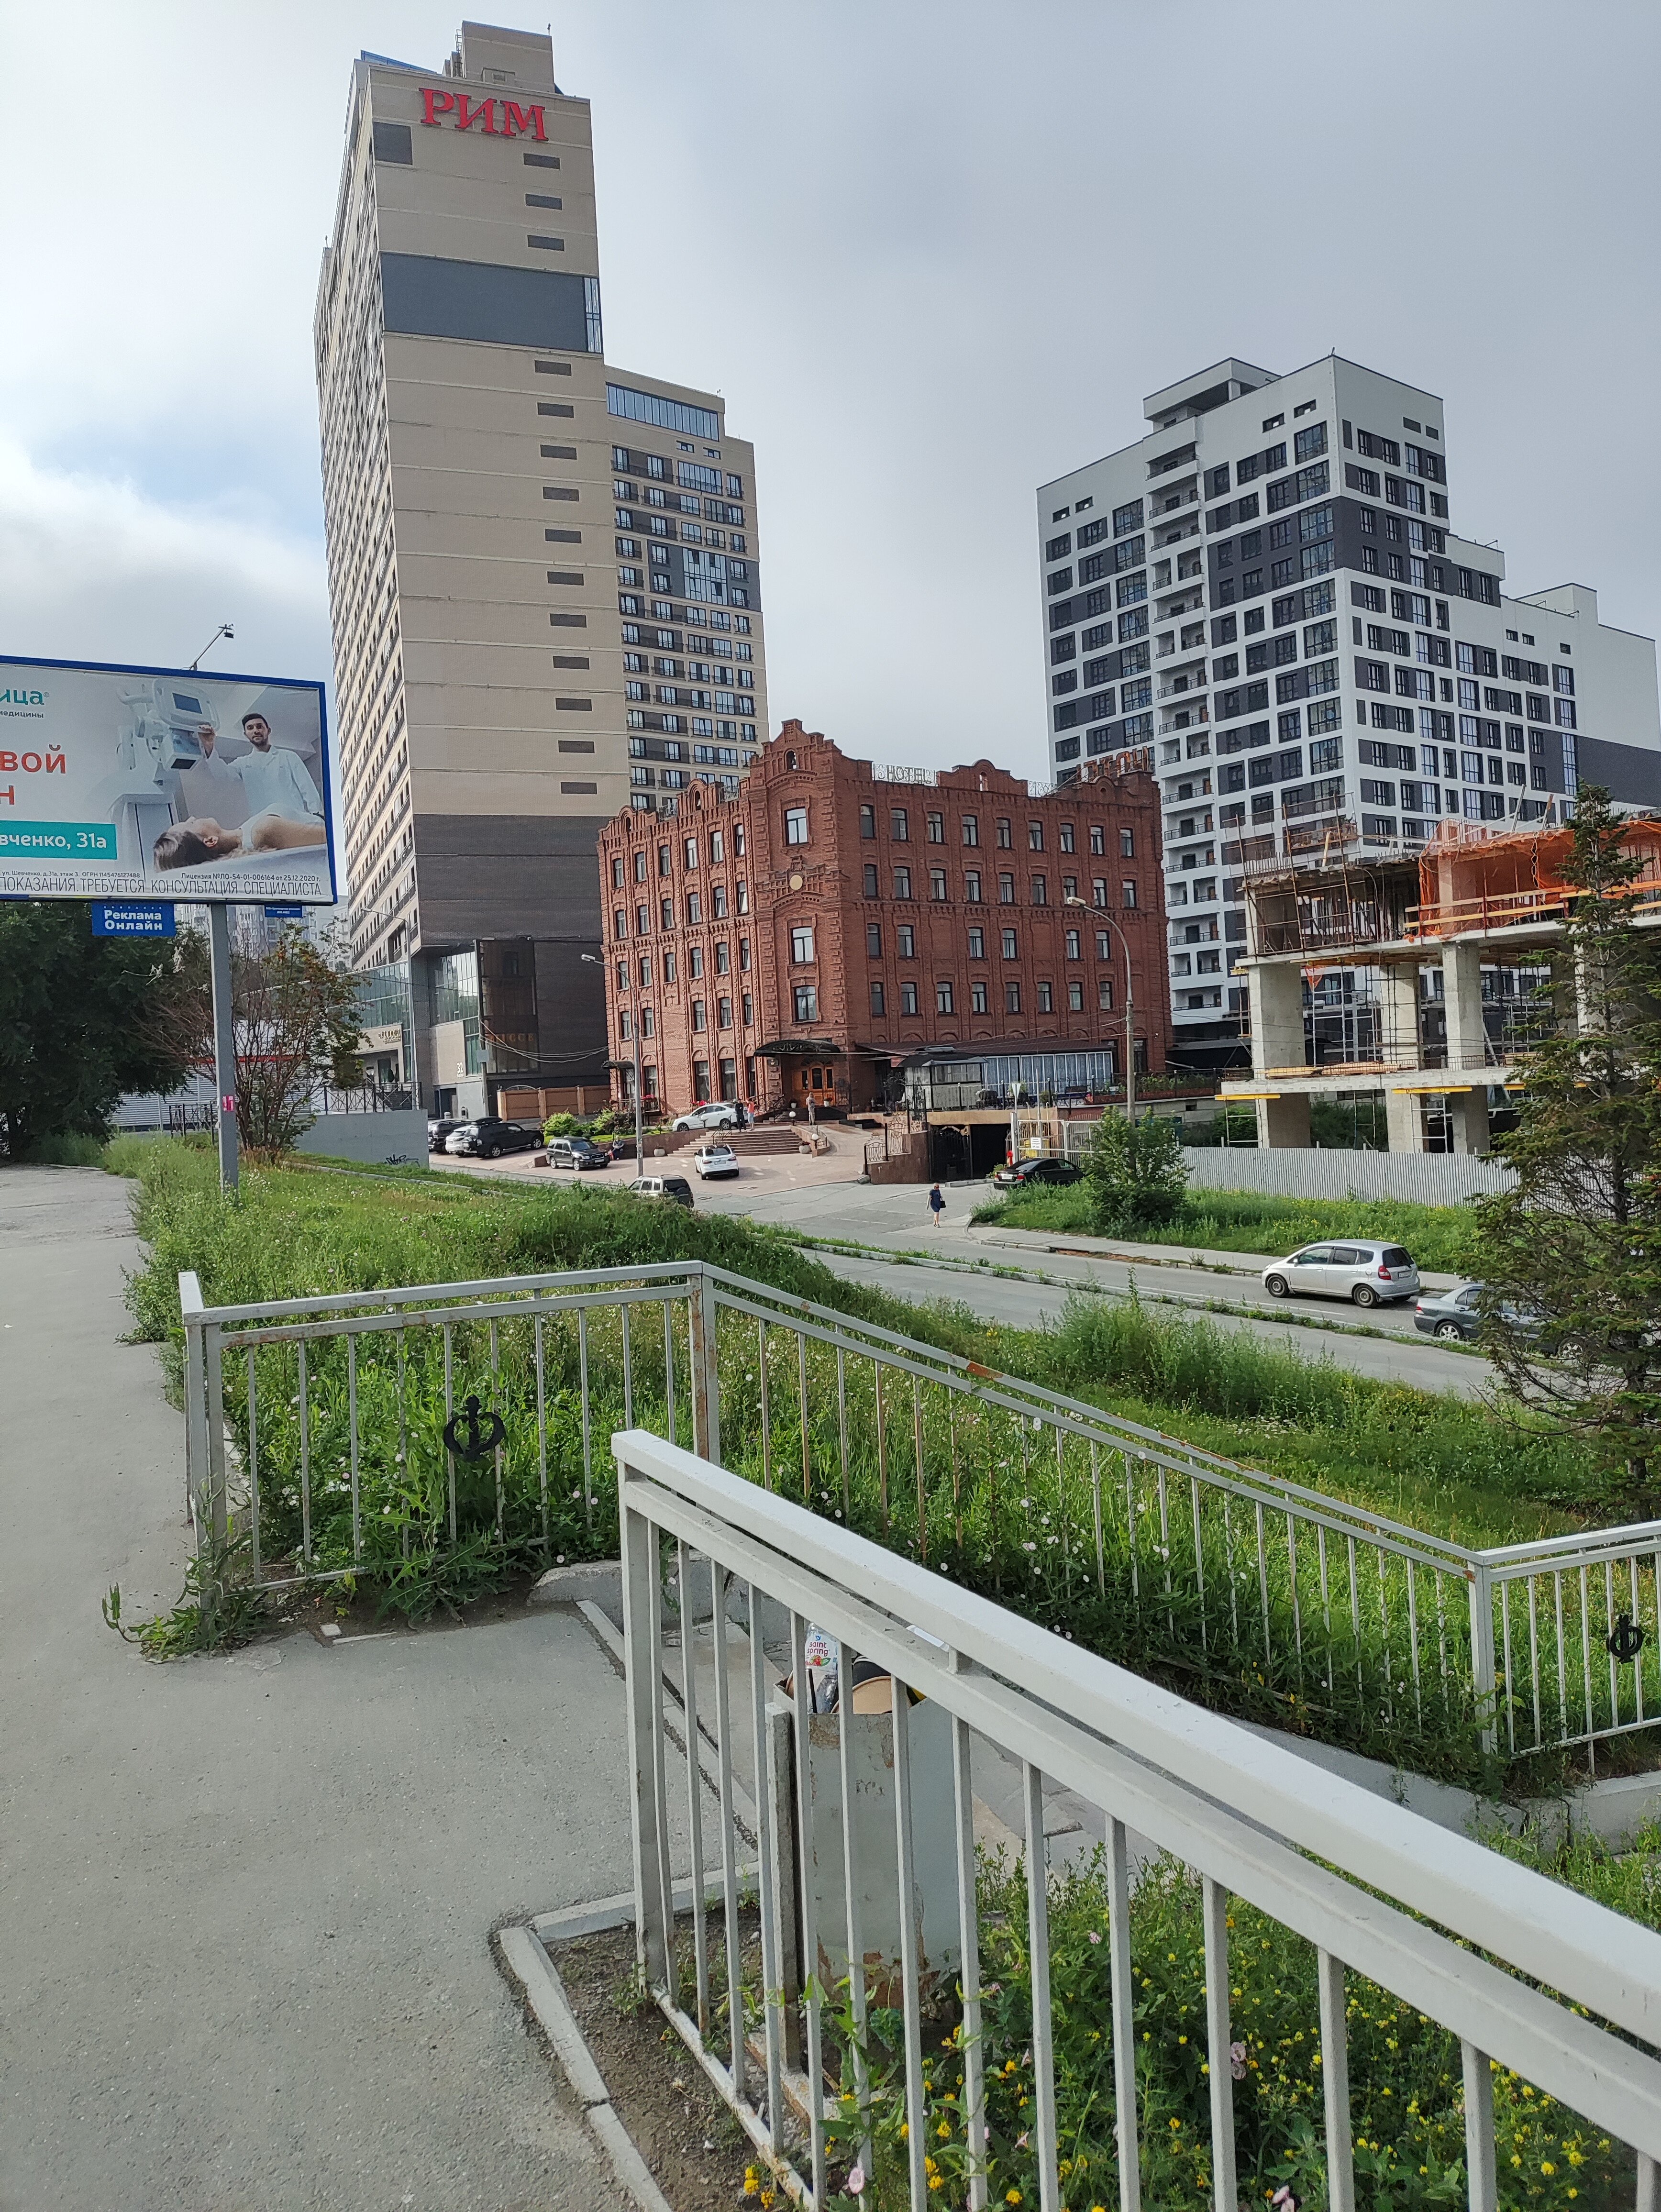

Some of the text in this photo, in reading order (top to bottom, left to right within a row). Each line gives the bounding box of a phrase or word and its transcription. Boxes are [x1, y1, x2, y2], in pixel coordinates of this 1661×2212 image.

[419, 88, 549, 141] РИМ
[0, 744, 66, 774] ВОЙ
[886, 765, 931, 784] HOTEL
[0, 832, 106, 850] вченко, 31а
[80, 878, 144, 893] ТРЕБУЕТСЯ
[151, 880, 238, 896] КОНСУЛЬТАЦИЯ
[244, 881, 321, 896] СПЕЦИАЛИСТА
[104, 910, 162, 920] Реклама
[105, 920, 163, 930] Онлайн
[457, 1062, 464, 1073] 32
[807, 1648, 829, 1657] spring
